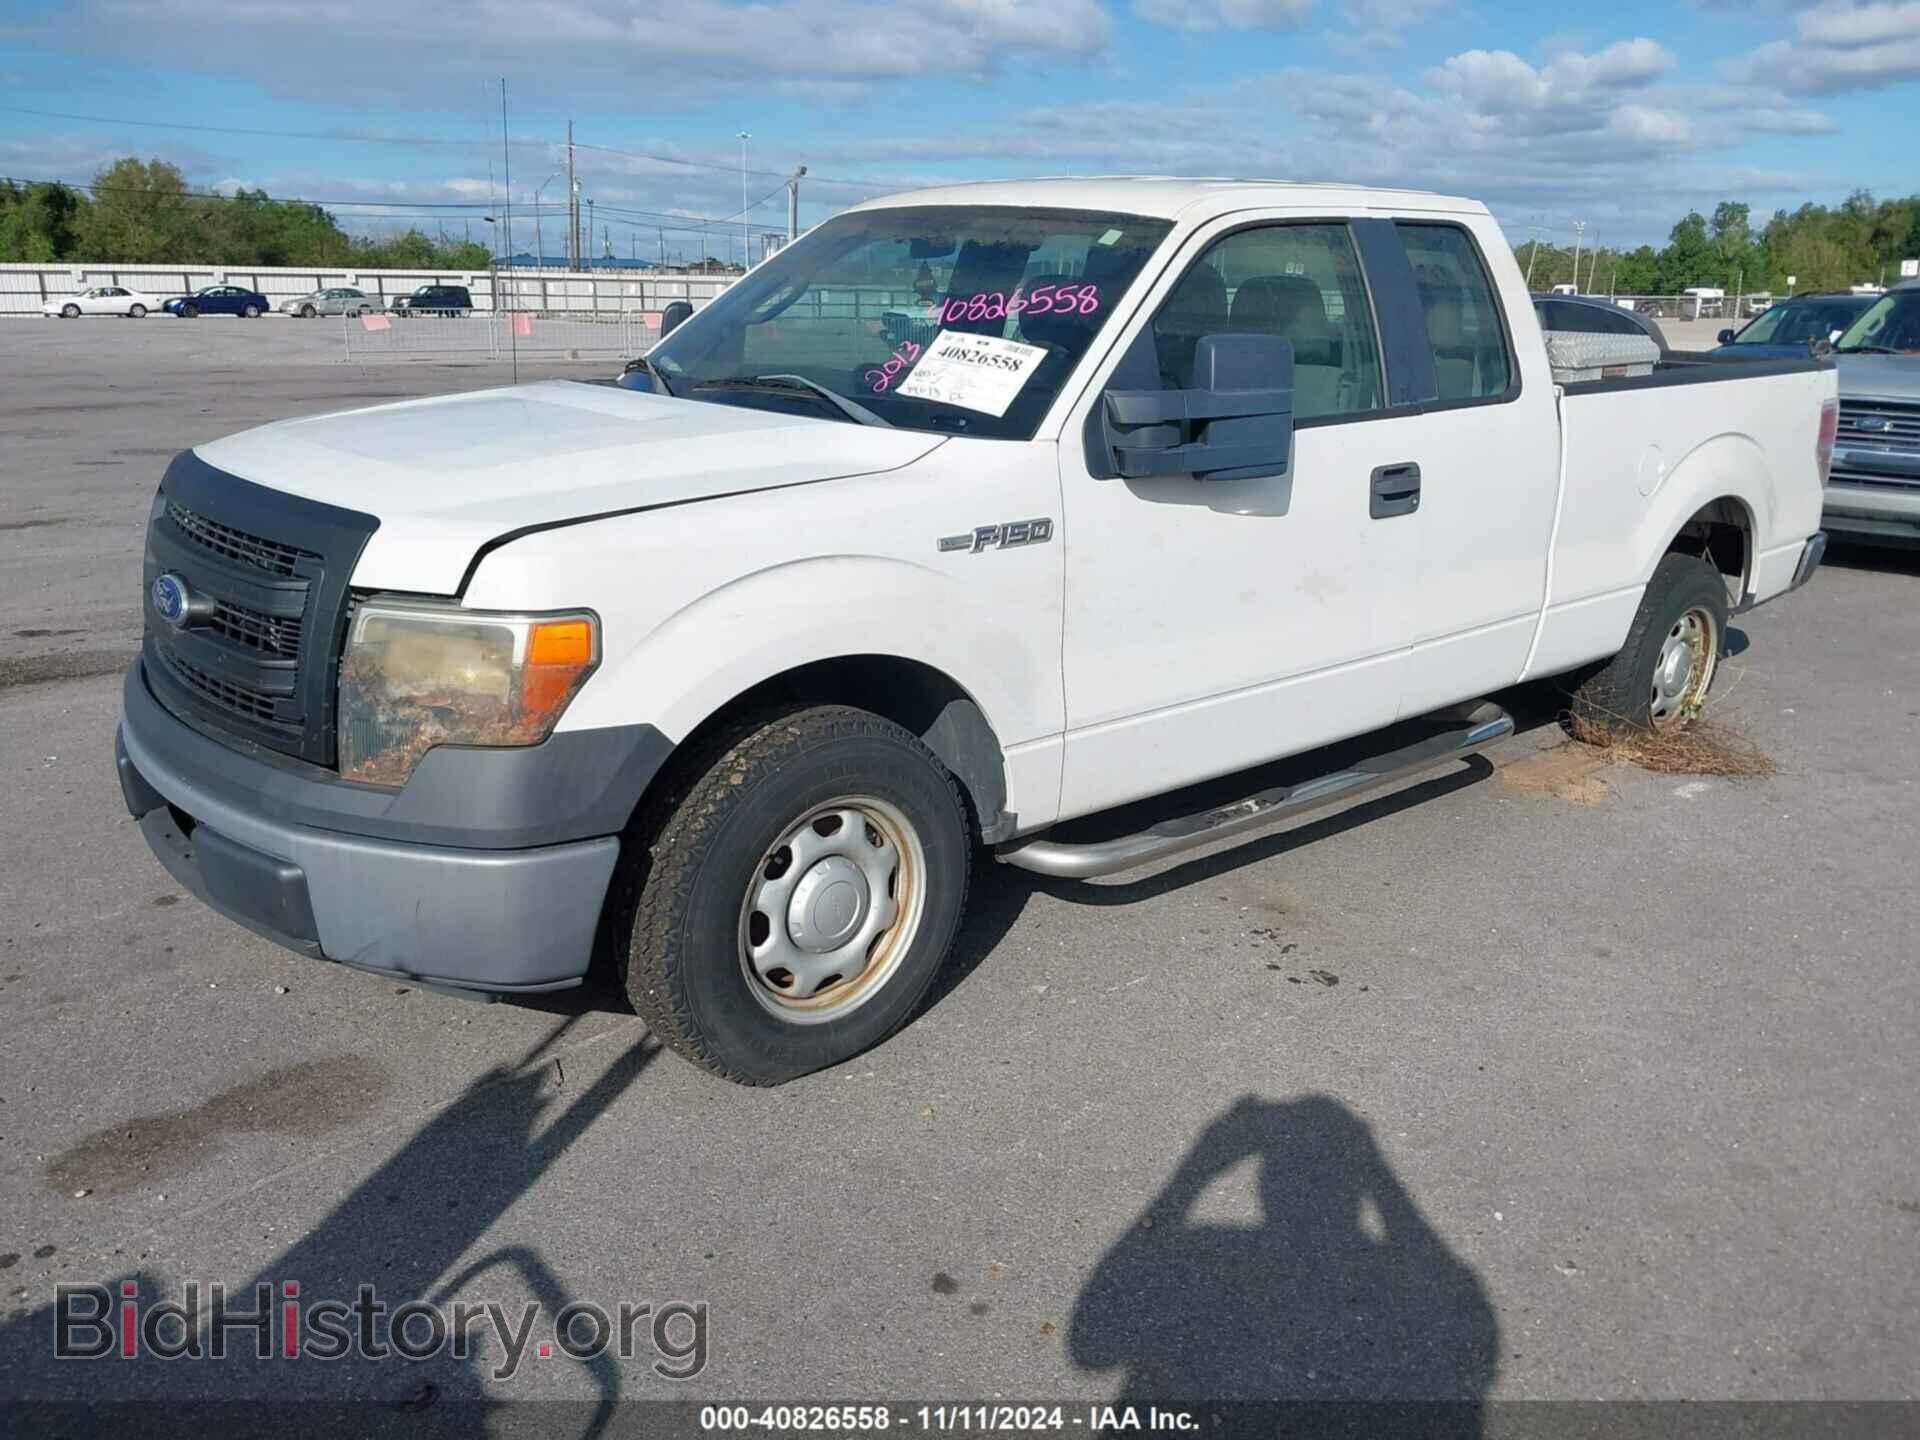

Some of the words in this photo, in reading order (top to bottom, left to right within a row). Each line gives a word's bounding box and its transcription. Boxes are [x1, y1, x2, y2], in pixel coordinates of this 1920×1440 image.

[927, 284, 1099, 326] 40826558
[864, 340, 920, 393] 2013
[938, 345, 1023, 372] 40826558
